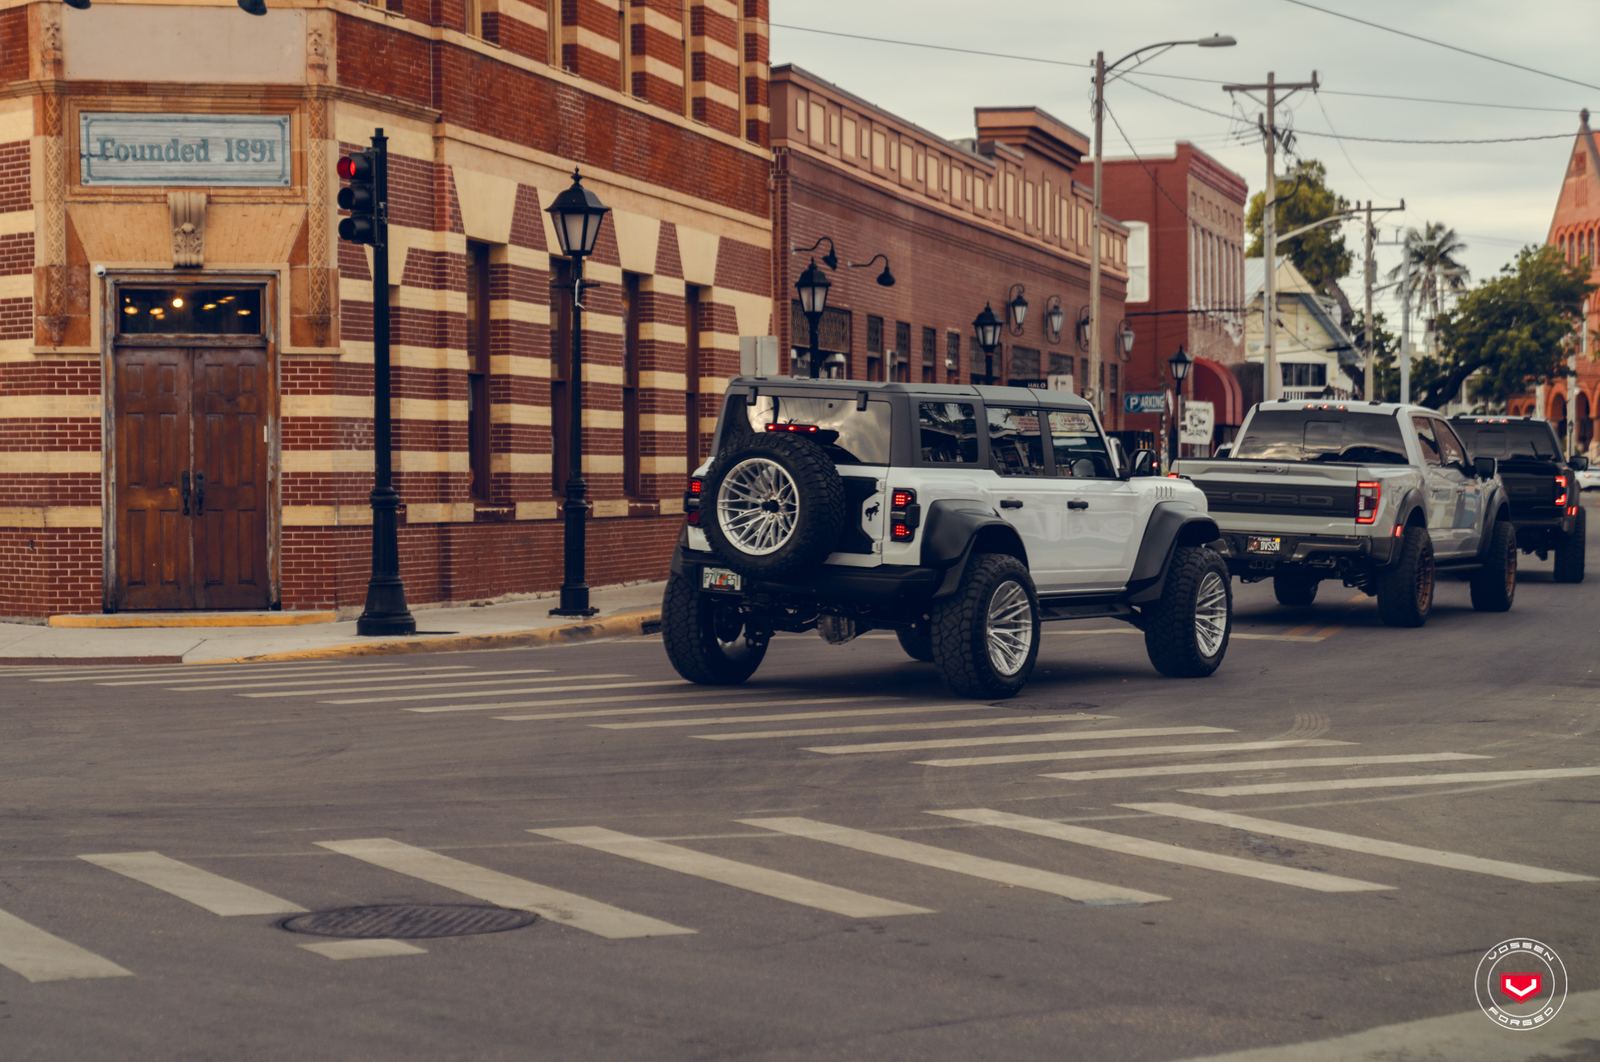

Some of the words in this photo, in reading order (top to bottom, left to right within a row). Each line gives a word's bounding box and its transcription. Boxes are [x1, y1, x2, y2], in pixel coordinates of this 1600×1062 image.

[97, 137, 210, 162] Founded
[225, 138, 276, 162] 1891
[1130, 395, 1165, 410] PARKING
[1205, 490, 1334, 507] FORD
